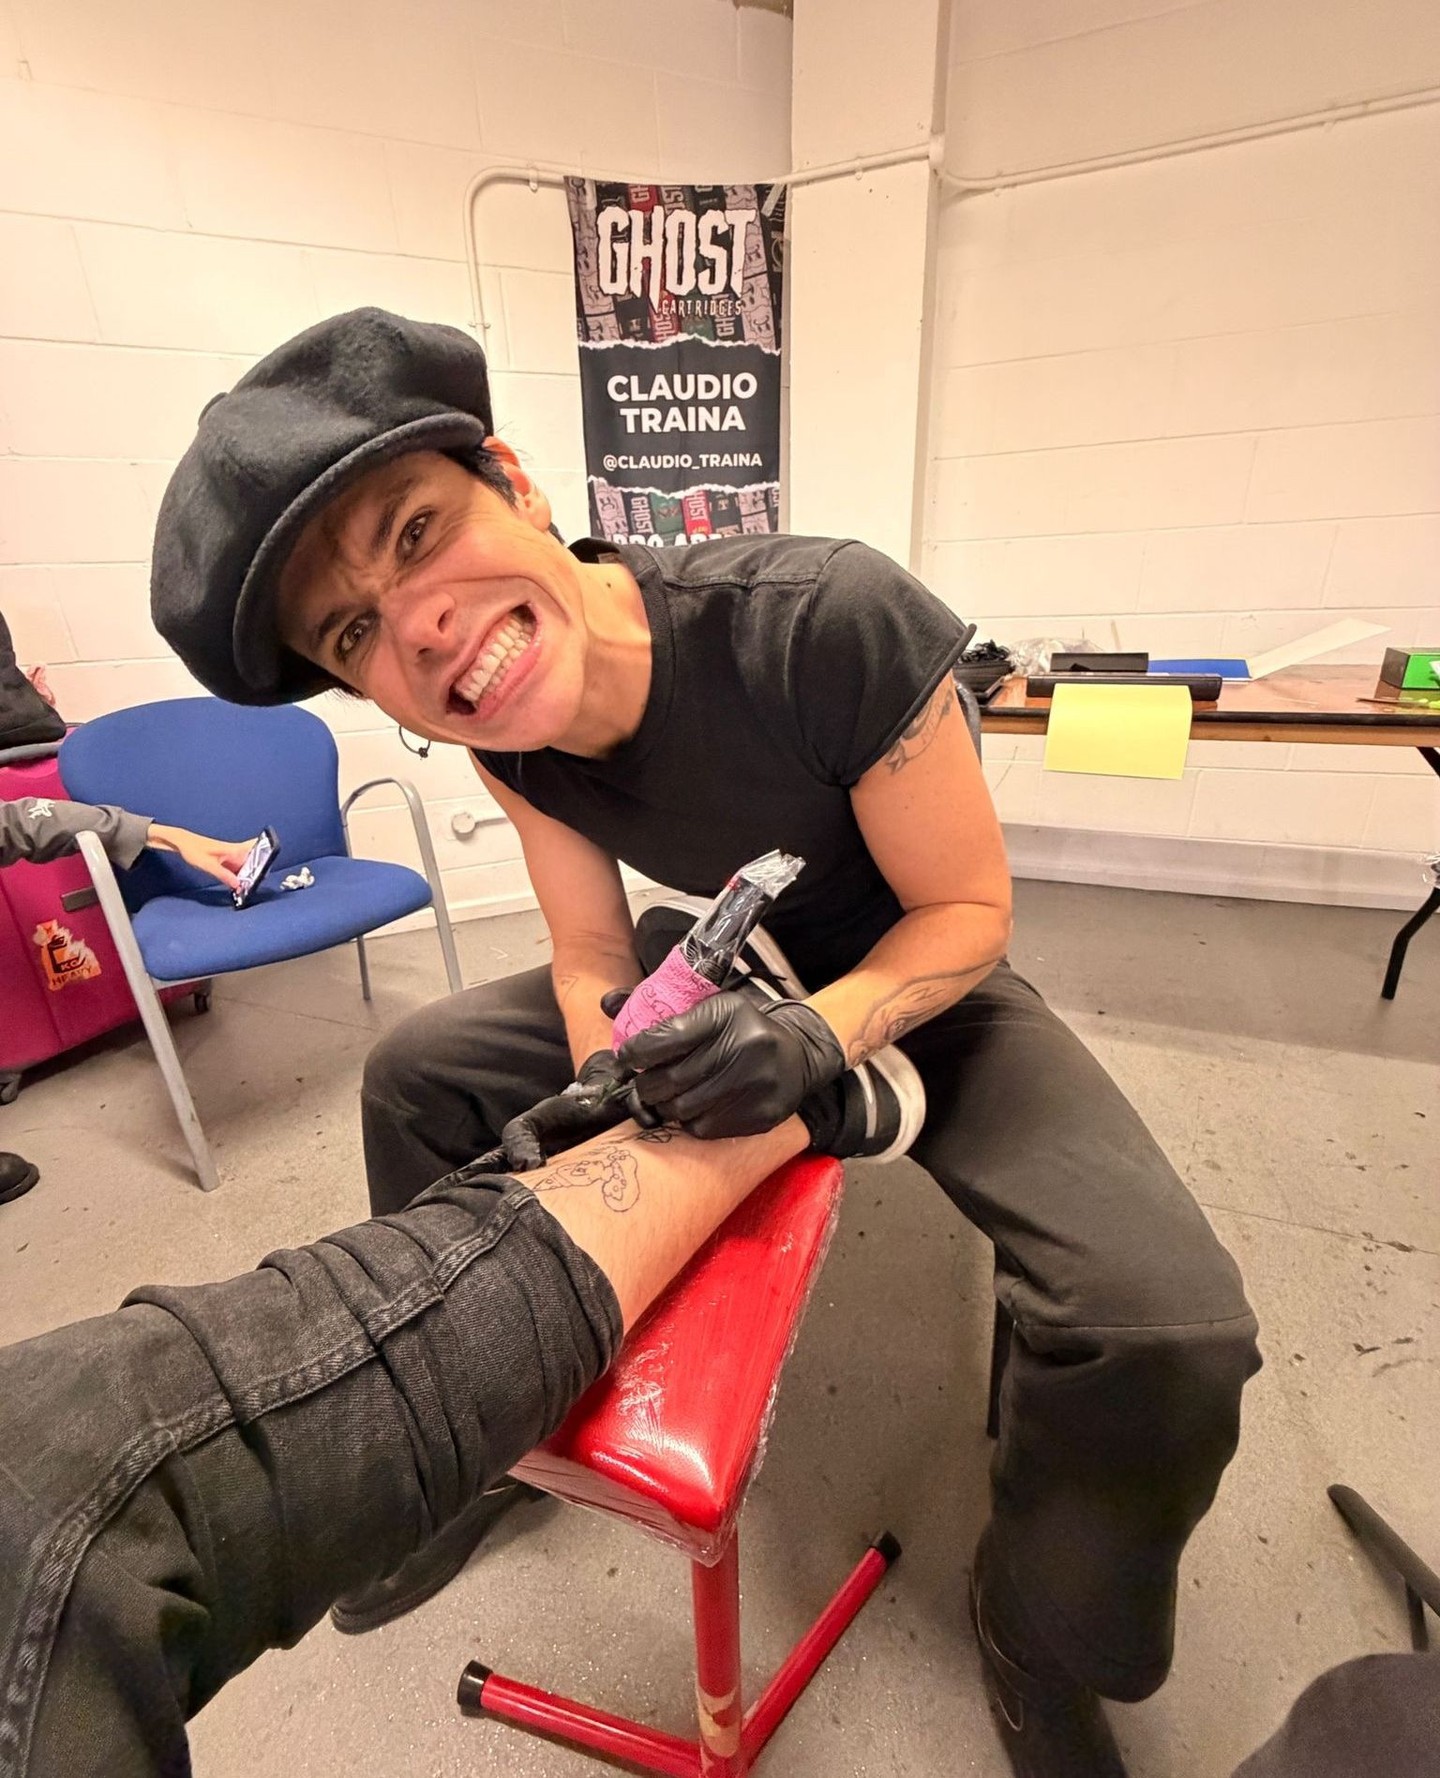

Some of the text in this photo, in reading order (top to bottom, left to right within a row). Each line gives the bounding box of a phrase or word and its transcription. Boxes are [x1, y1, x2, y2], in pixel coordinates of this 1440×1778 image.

[597, 205, 756, 314] GHOST
[662, 299, 742, 318] CARTRIDGES
[607, 372, 758, 402] CLAUDIO
[620, 405, 746, 433] TRAINA
[603, 453, 763, 471] @CLAUDIO_TRAINA
[631, 496, 654, 533] GHOST
